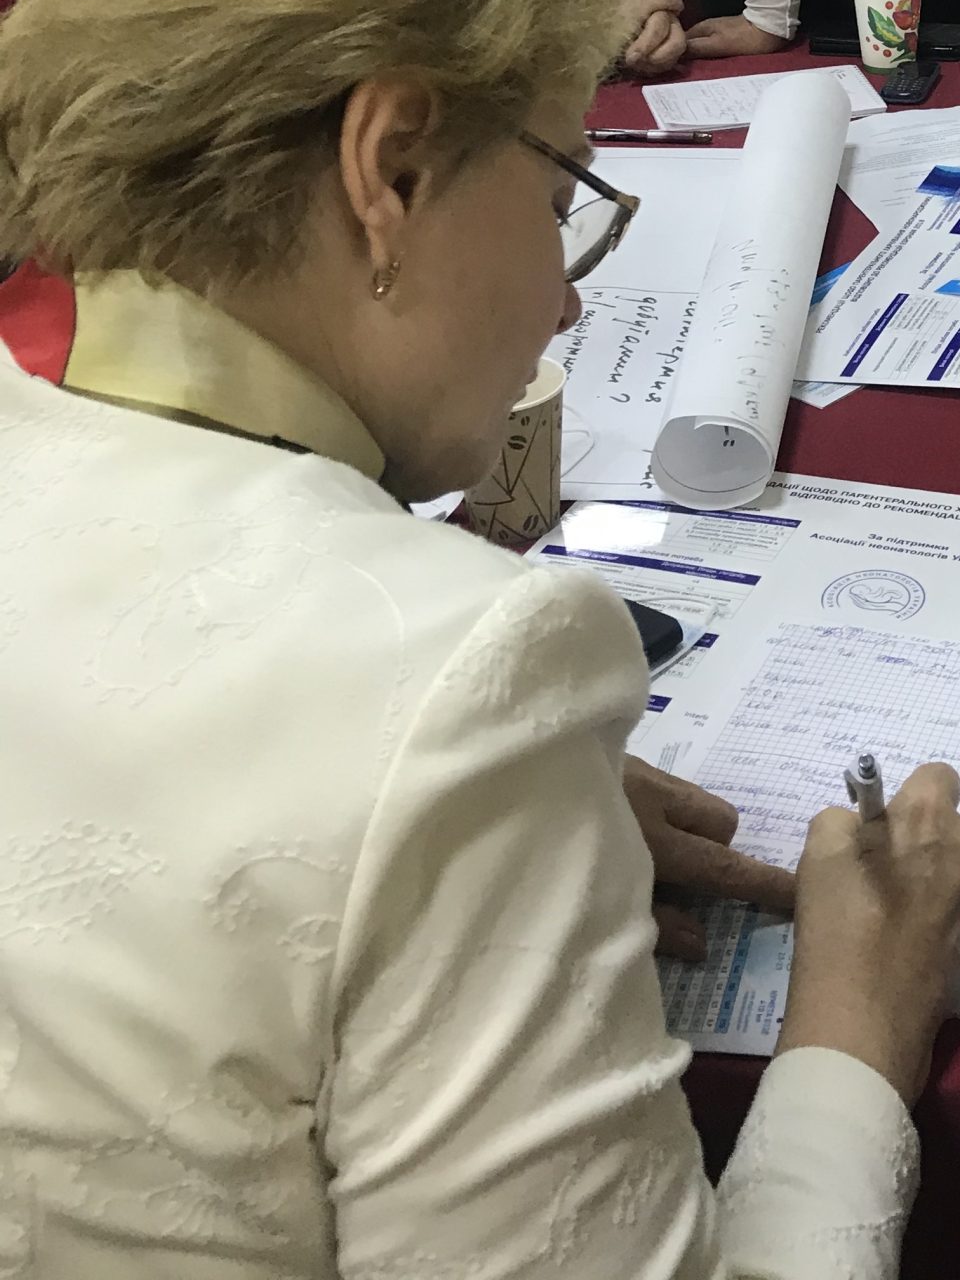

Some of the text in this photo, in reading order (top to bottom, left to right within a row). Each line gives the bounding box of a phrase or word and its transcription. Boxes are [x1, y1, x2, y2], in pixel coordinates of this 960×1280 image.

[789, 491, 862, 506] ВІДПОВІДНО
[862, 500, 882, 509] ДО
[801, 484, 838, 496] ЩОДО
[840, 489, 953, 512] ПАРЕНТЕРАЛЬНОГО
[810, 532, 866, 548] Асоціації
[868, 541, 949, 560] неонатологів
[867, 532, 950, 552] За підтримки
